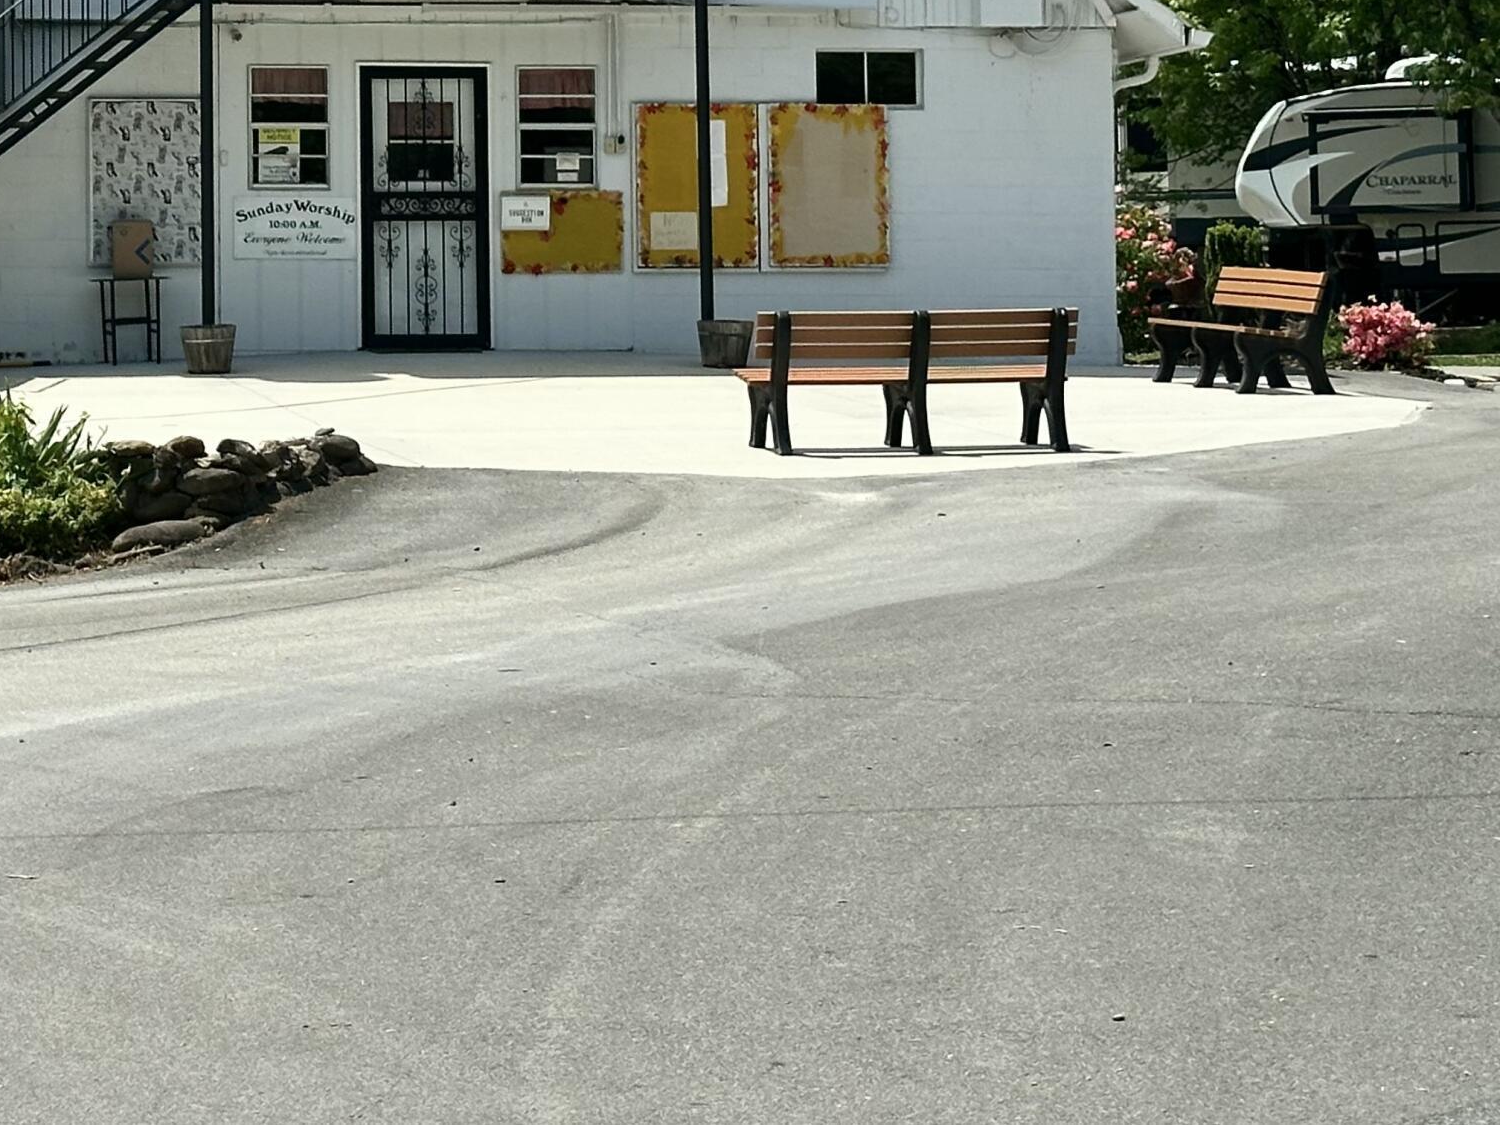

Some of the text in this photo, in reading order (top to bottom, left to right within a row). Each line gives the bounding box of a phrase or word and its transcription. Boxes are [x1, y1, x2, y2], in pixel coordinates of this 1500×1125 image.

[1366, 174, 1457, 188] CHAPARRAL
[235, 199, 356, 225] Sunday Worship
[269, 220, 297, 229] 10:00
[243, 231, 346, 246] Everyone Welcome
